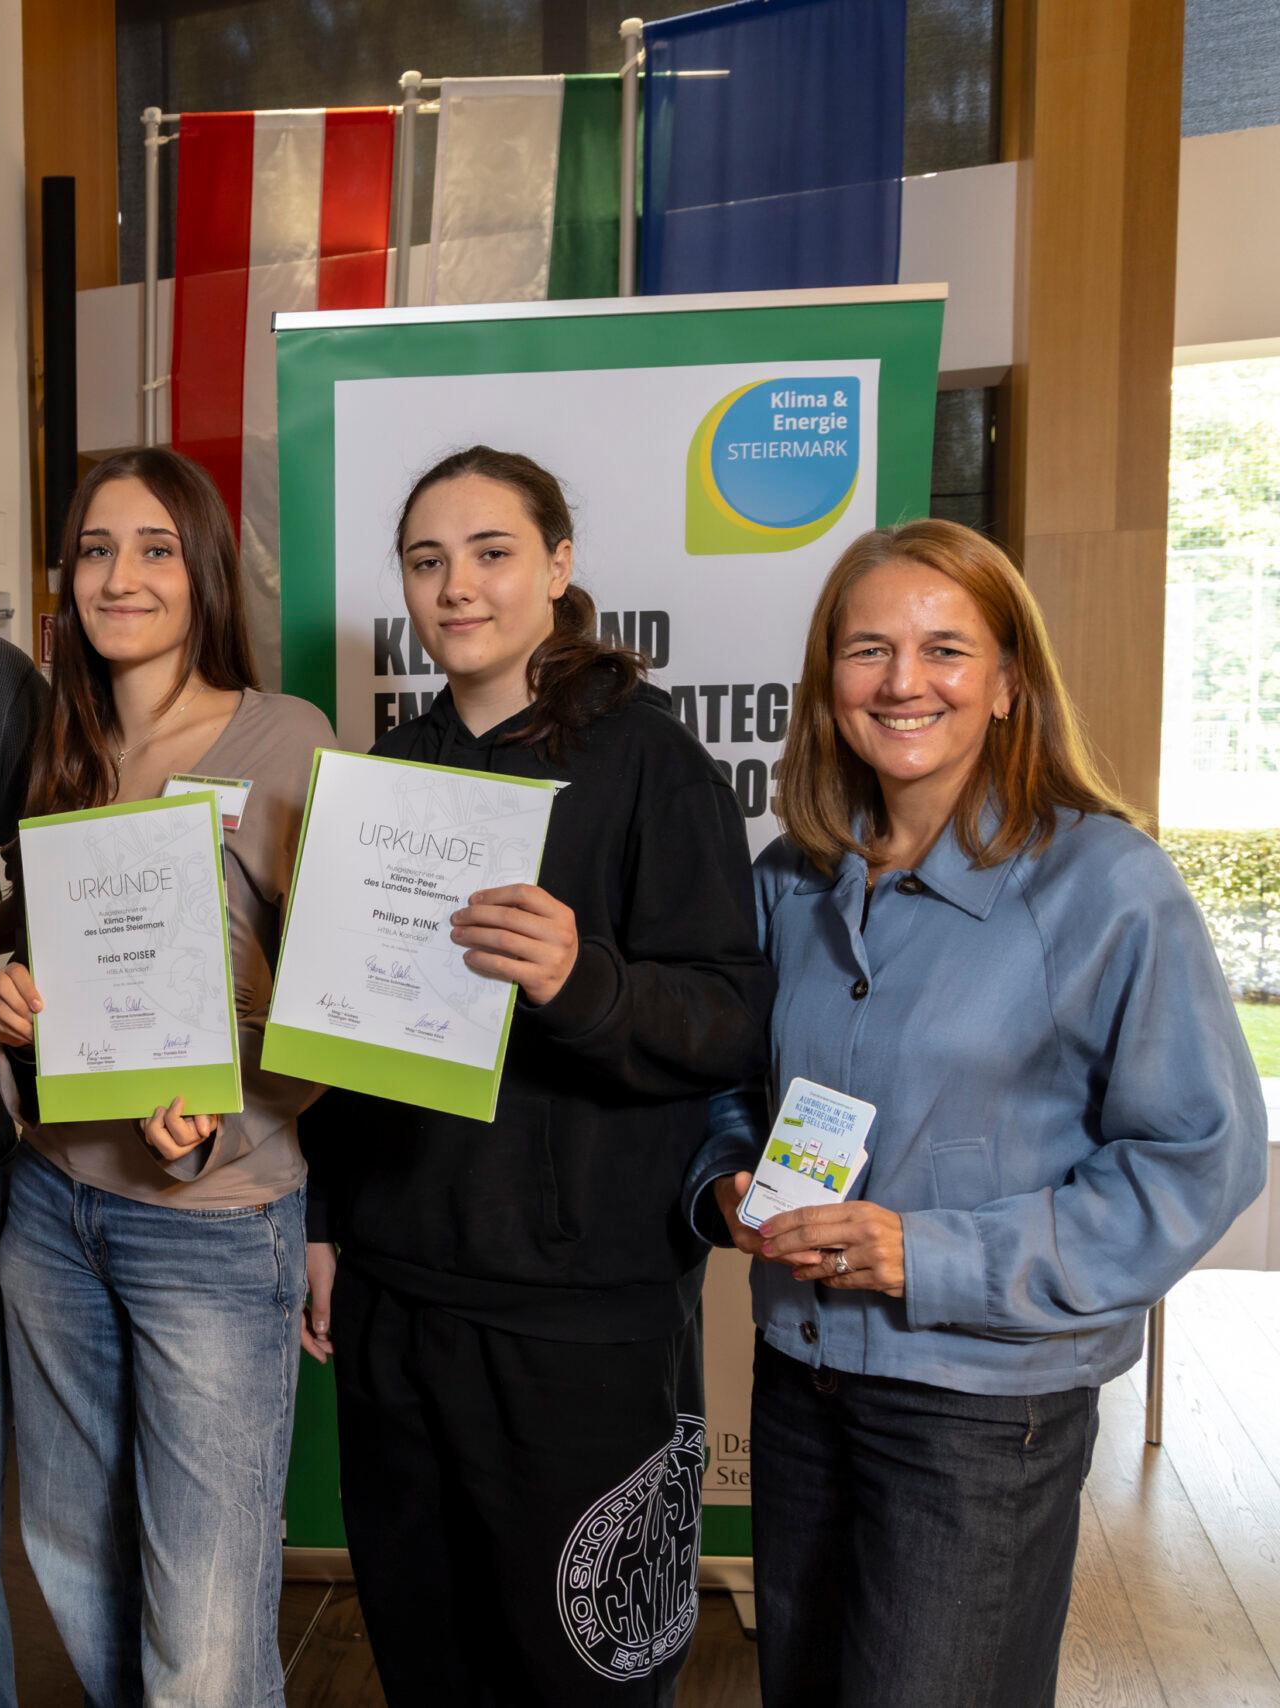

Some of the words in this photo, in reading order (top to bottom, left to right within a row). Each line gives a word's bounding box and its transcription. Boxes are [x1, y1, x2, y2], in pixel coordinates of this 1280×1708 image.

[770, 391, 827, 409] Klima
[832, 390, 848, 408] &
[773, 412, 848, 434] Energie
[727, 440, 848, 460] STEIERMARK
[359, 822, 486, 867] URKUNDE
[68, 868, 173, 901] URKUNDE
[363, 877, 380, 887] des
[381, 881, 412, 893] Landes
[414, 888, 460, 903] Steiermark
[390, 873, 437, 889] Klima-Peer
[84, 928, 98, 936] des
[99, 926, 125, 935] Landes
[126, 921, 165, 931] Steiermark
[104, 915, 144, 925] Klima-Peer
[372, 909, 410, 926] Philipp
[412, 918, 440, 931] KINK
[97, 953, 121, 964] Frida
[123, 950, 156, 961] ROISER
